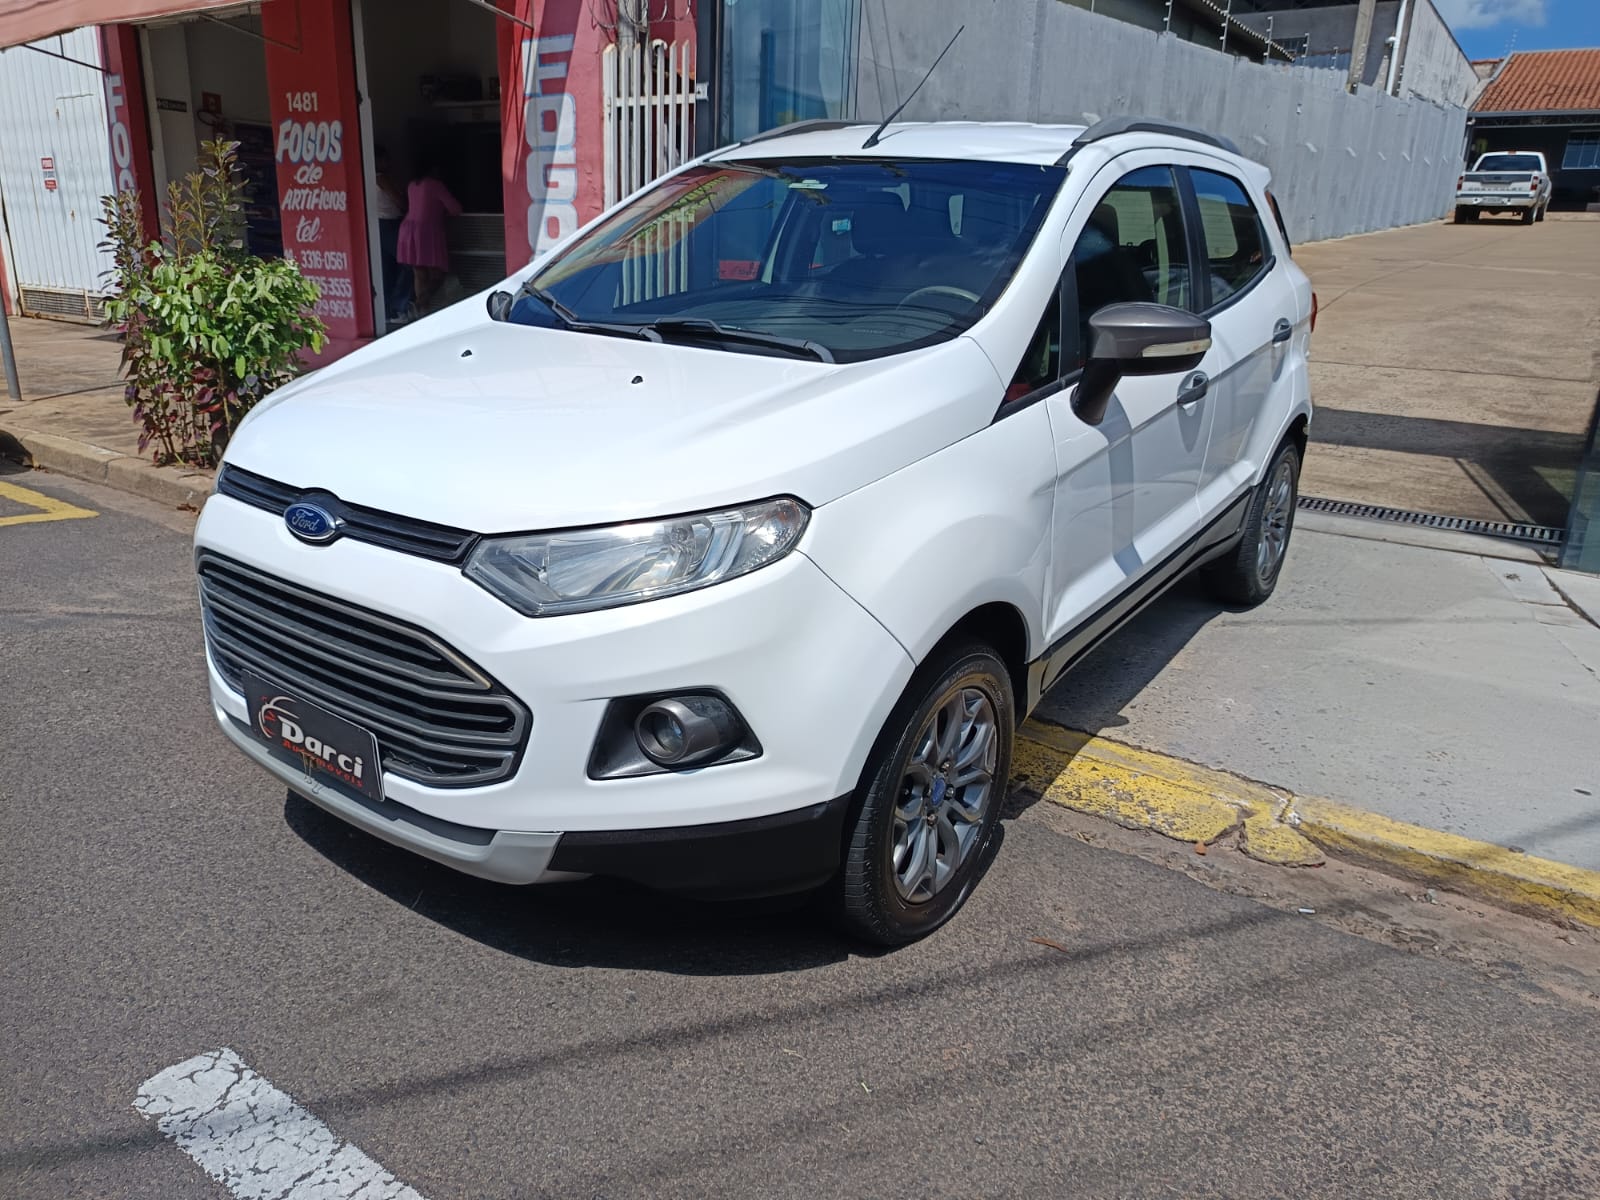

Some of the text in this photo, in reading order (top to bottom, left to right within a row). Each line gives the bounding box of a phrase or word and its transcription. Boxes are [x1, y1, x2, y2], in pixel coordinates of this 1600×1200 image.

[285, 91, 319, 113] 1481
[275, 118, 344, 163] FOGOS
[521, 33, 578, 262] FOGO
[293, 162, 324, 185] de
[291, 508, 320, 532] Ford
[277, 714, 364, 779] Darci
